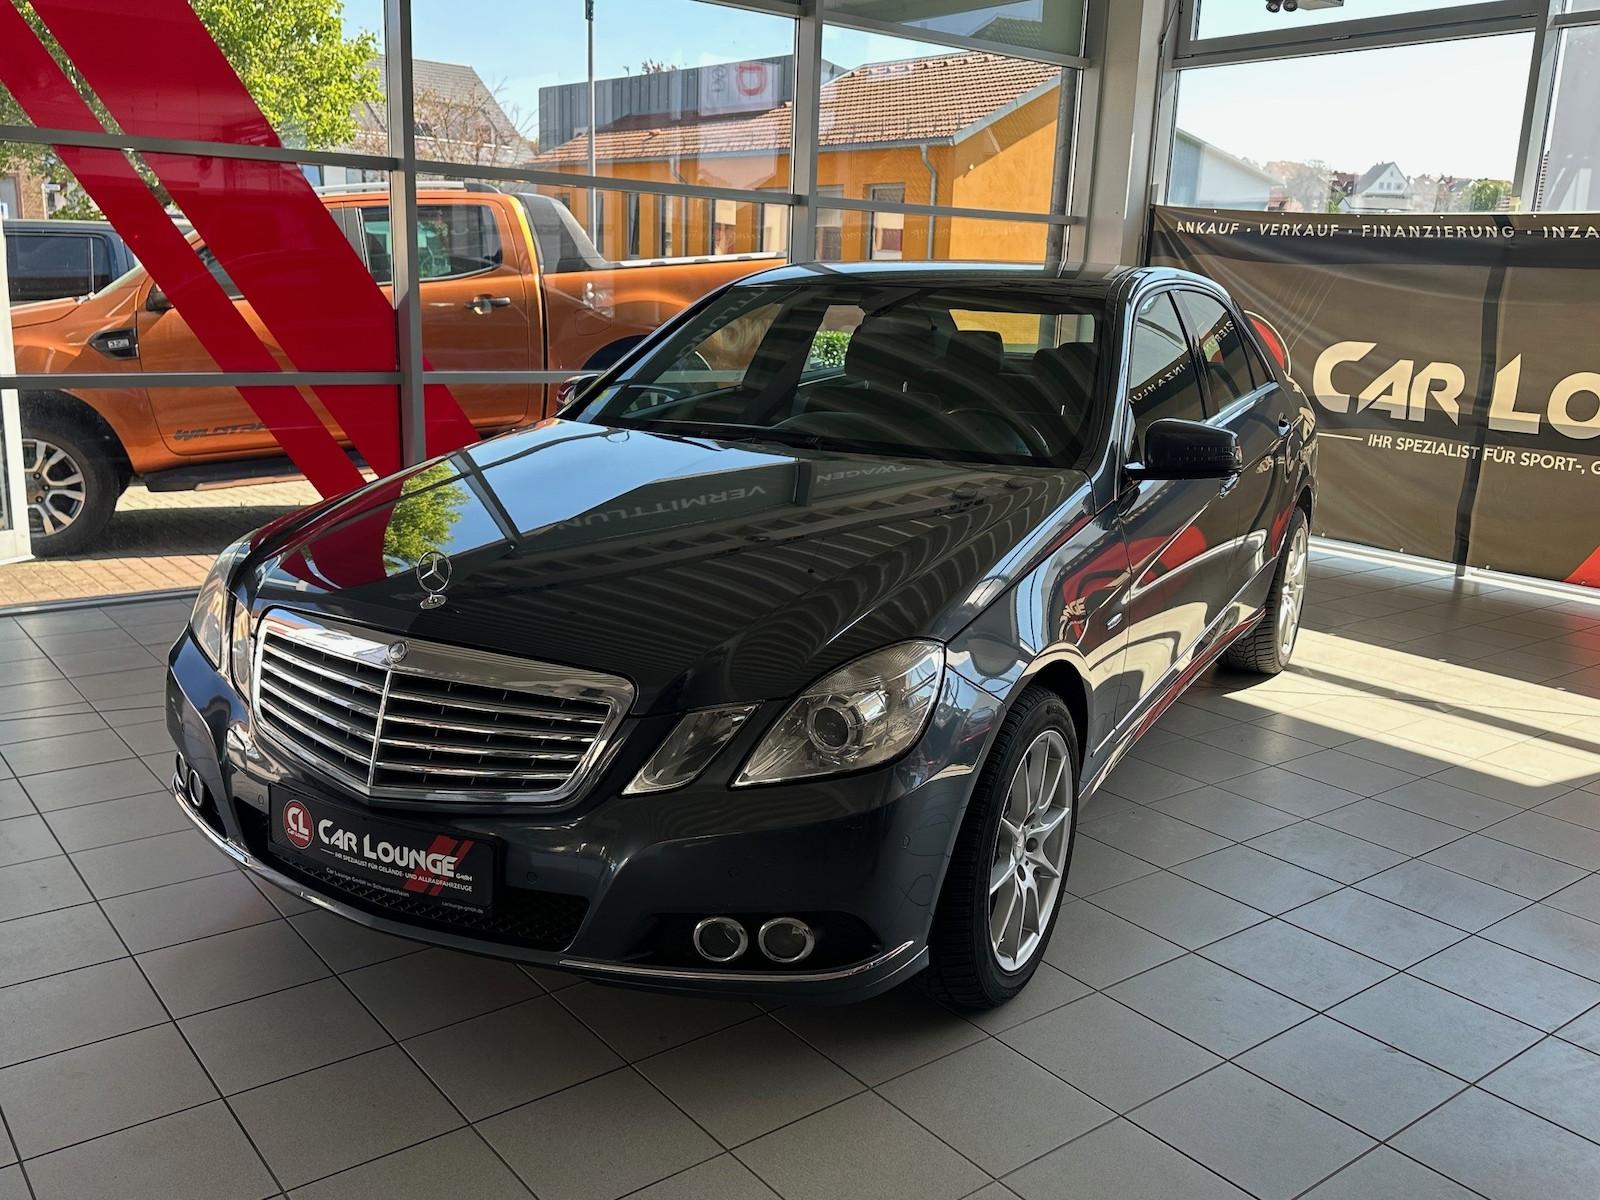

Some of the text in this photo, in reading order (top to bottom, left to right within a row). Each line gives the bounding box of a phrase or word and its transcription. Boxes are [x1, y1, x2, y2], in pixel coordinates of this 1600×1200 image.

[1177, 221, 1600, 239] ANKAUF VERKAUF FINANZIERUNG INZA
[1312, 340, 1600, 440] CAR LO
[1367, 433, 1392, 449] IHR
[1395, 437, 1480, 460] SPEZIALIST
[1483, 446, 1516, 465] FÜR
[1519, 451, 1586, 475] SPORT-,
[287, 806, 309, 835] CL
[318, 818, 358, 854] CAR
[363, 833, 458, 878] LOUNGE
[405, 872, 418, 880] UND
[418, 875, 473, 893] ALLRADFAHRZEUGE
